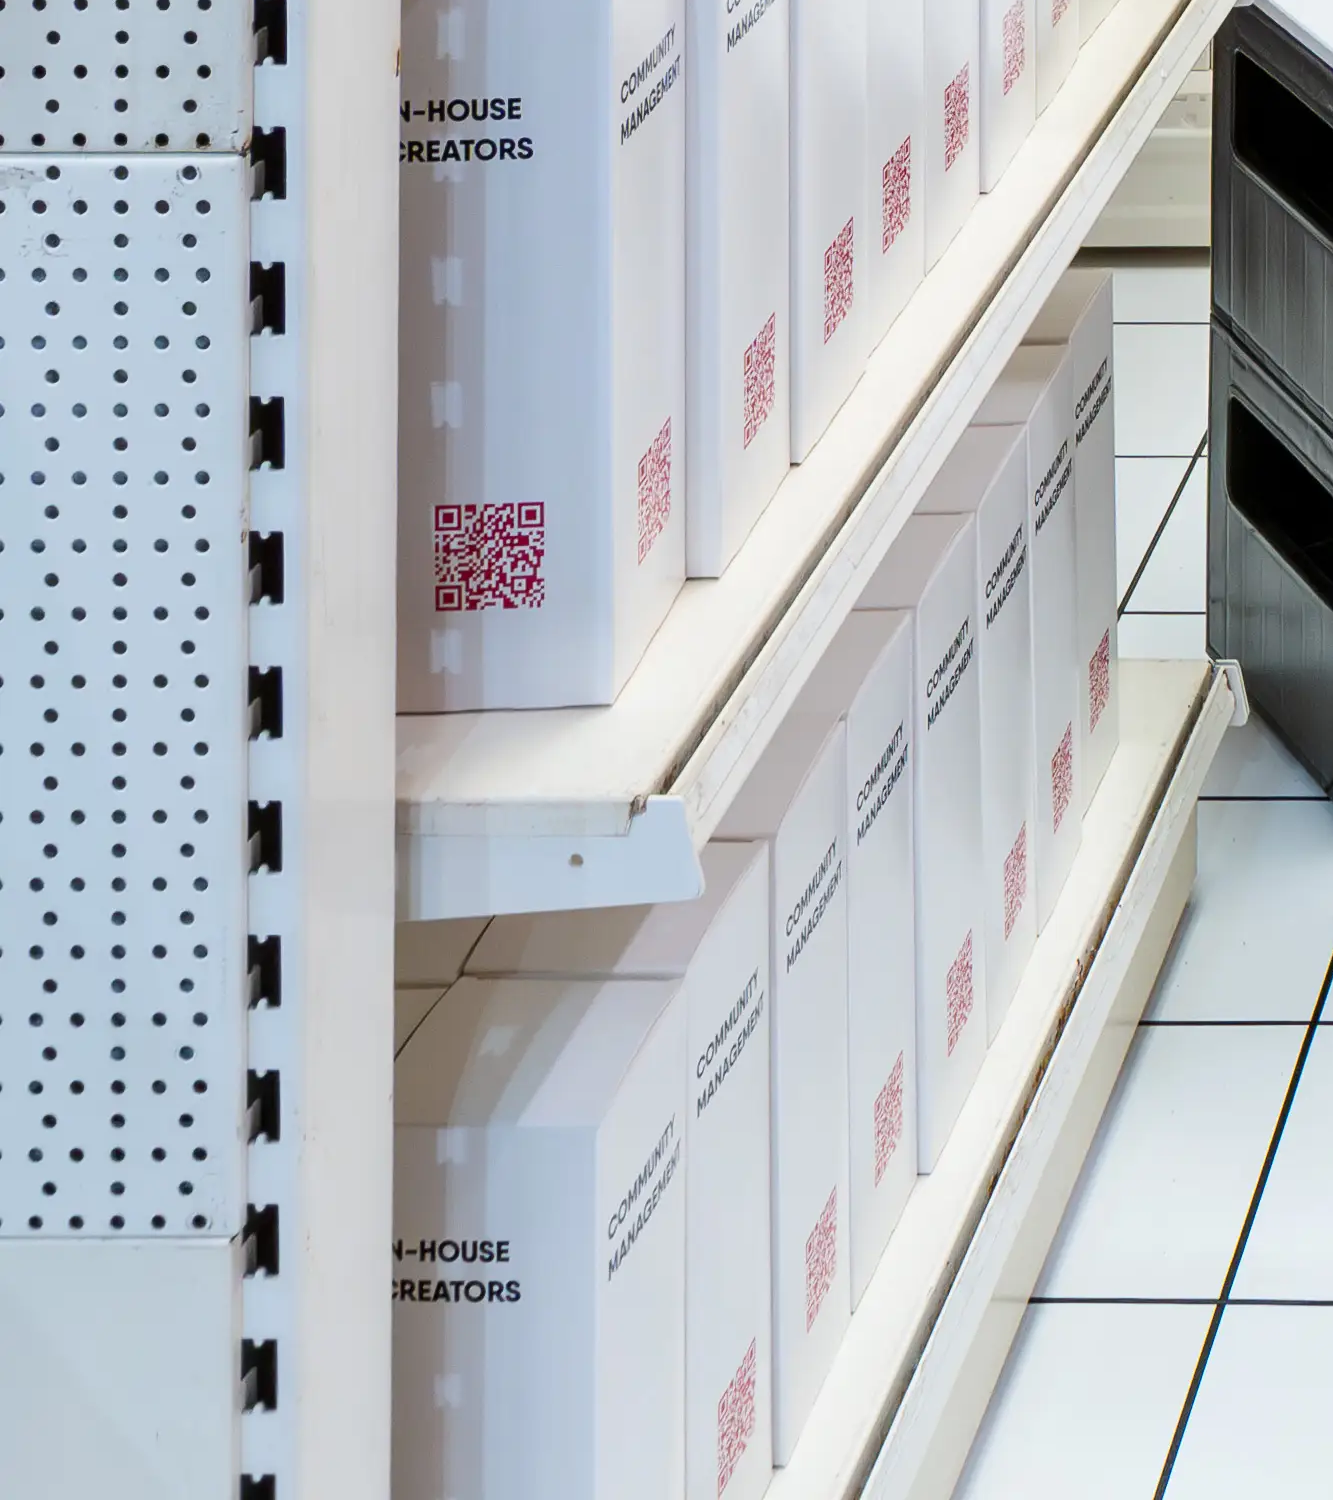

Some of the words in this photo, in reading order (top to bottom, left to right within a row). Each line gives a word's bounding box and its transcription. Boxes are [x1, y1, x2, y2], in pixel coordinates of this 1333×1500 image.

[620, 23, 674, 104] COMMUNITY
[620, 54, 680, 145] MANAGEMENT
[696, 967, 759, 1080] COMMUNITY
[697, 991, 764, 1118] MANAGEMENT
[608, 1113, 676, 1239] COMMUNITY
[608, 1139, 681, 1282] MANAGEMENT
